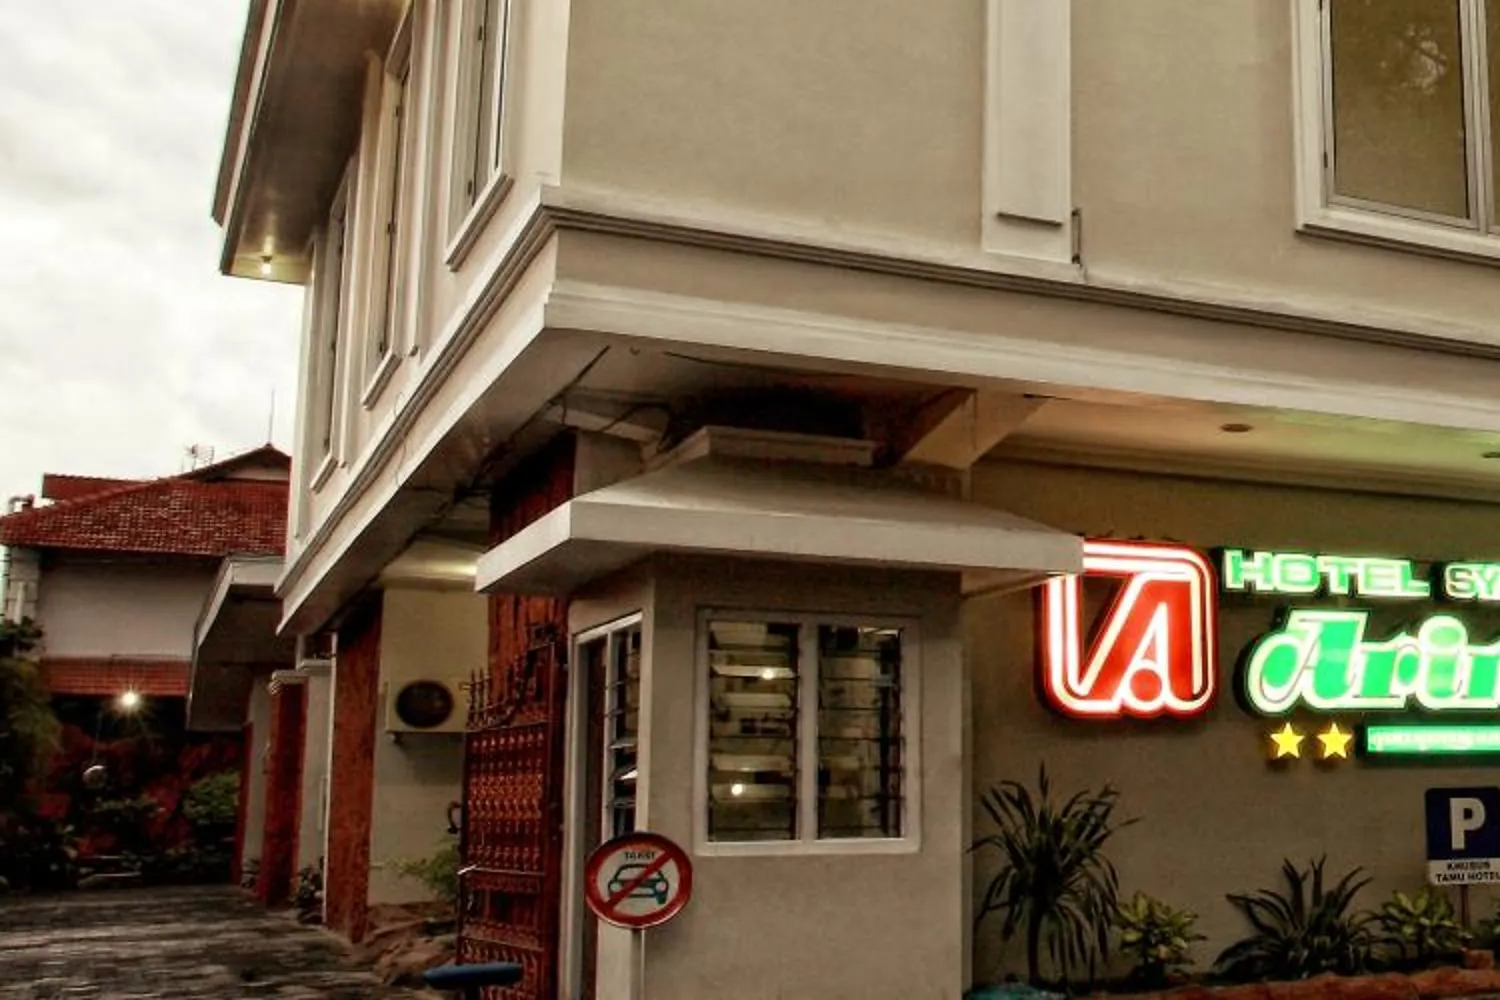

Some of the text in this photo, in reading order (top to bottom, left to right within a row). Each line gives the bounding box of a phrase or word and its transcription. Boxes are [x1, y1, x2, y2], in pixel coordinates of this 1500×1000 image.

[1223, 549, 1430, 597] HOTEL
[1450, 797, 1486, 849] P
[1435, 872, 1465, 882] TAMU
